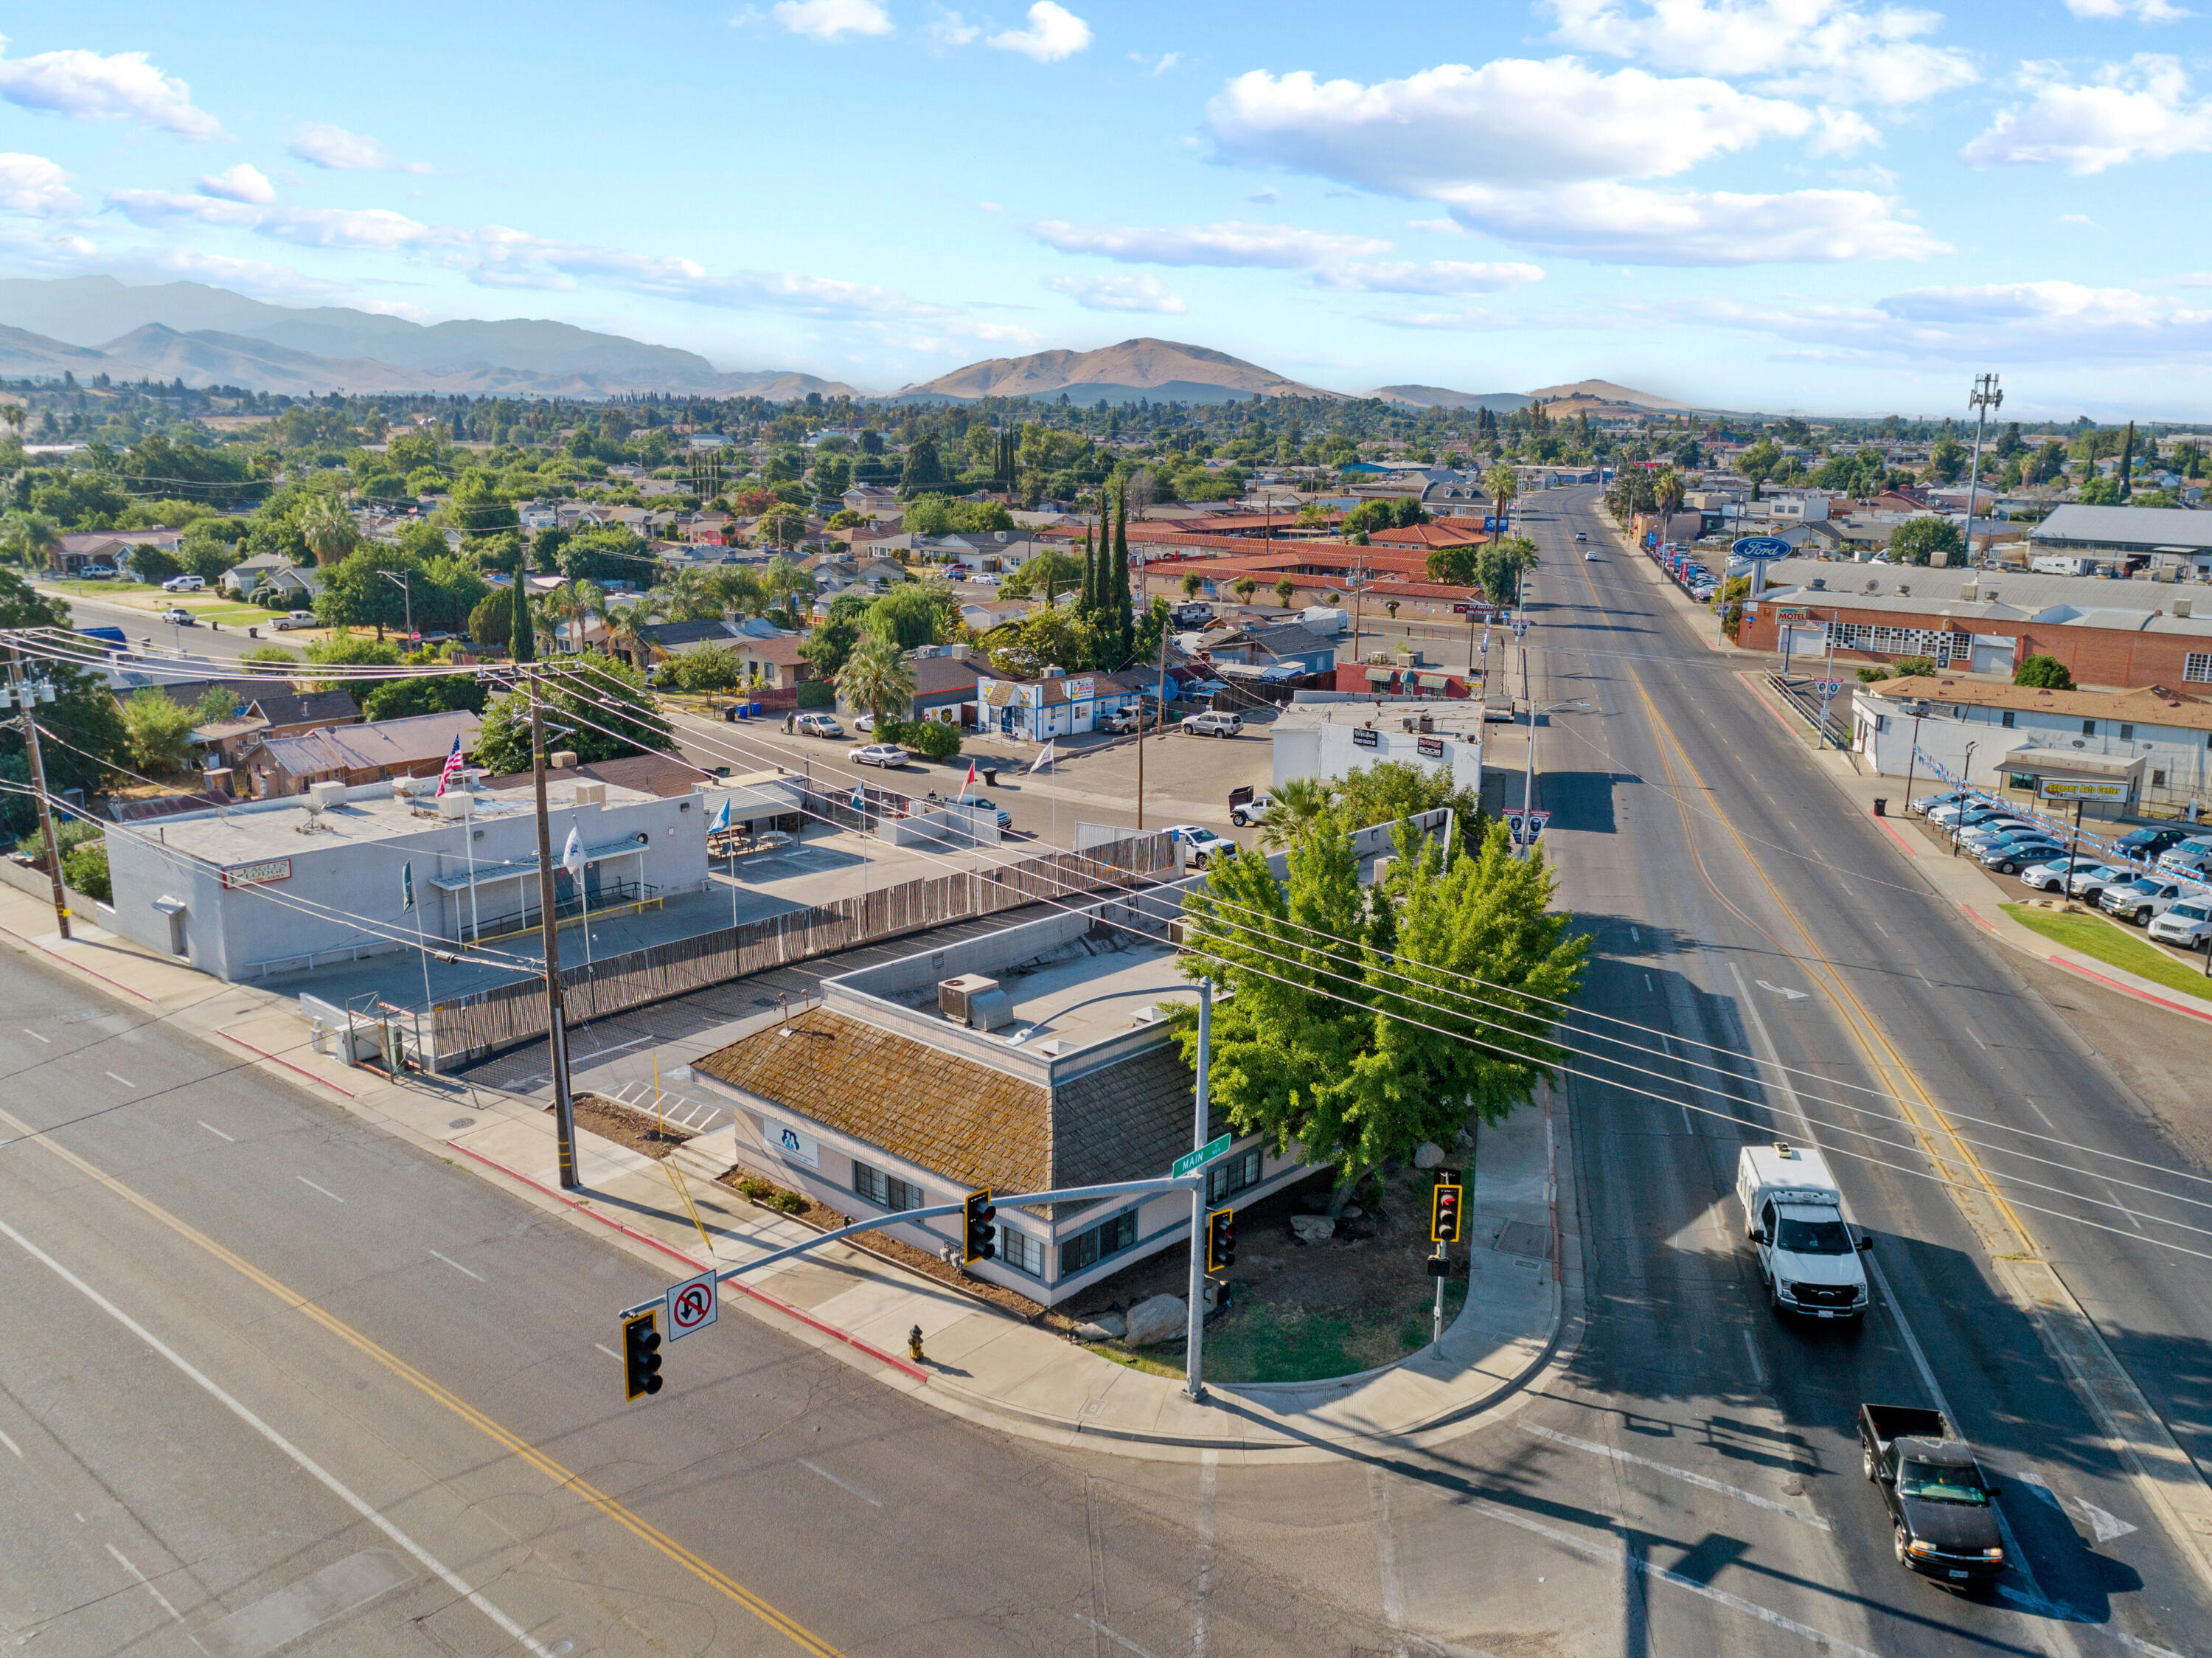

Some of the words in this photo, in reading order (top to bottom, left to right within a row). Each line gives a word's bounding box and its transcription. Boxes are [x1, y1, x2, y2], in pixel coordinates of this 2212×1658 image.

[1745, 541, 1779, 555] Ford
[2049, 783, 2078, 794] Economy
[2080, 784, 2096, 793] Auto
[2097, 785, 2121, 795] Center
[243, 861, 287, 874] EAGLES
[246, 868, 284, 879] LODGE
[1183, 1151, 1203, 1170] MAIN
